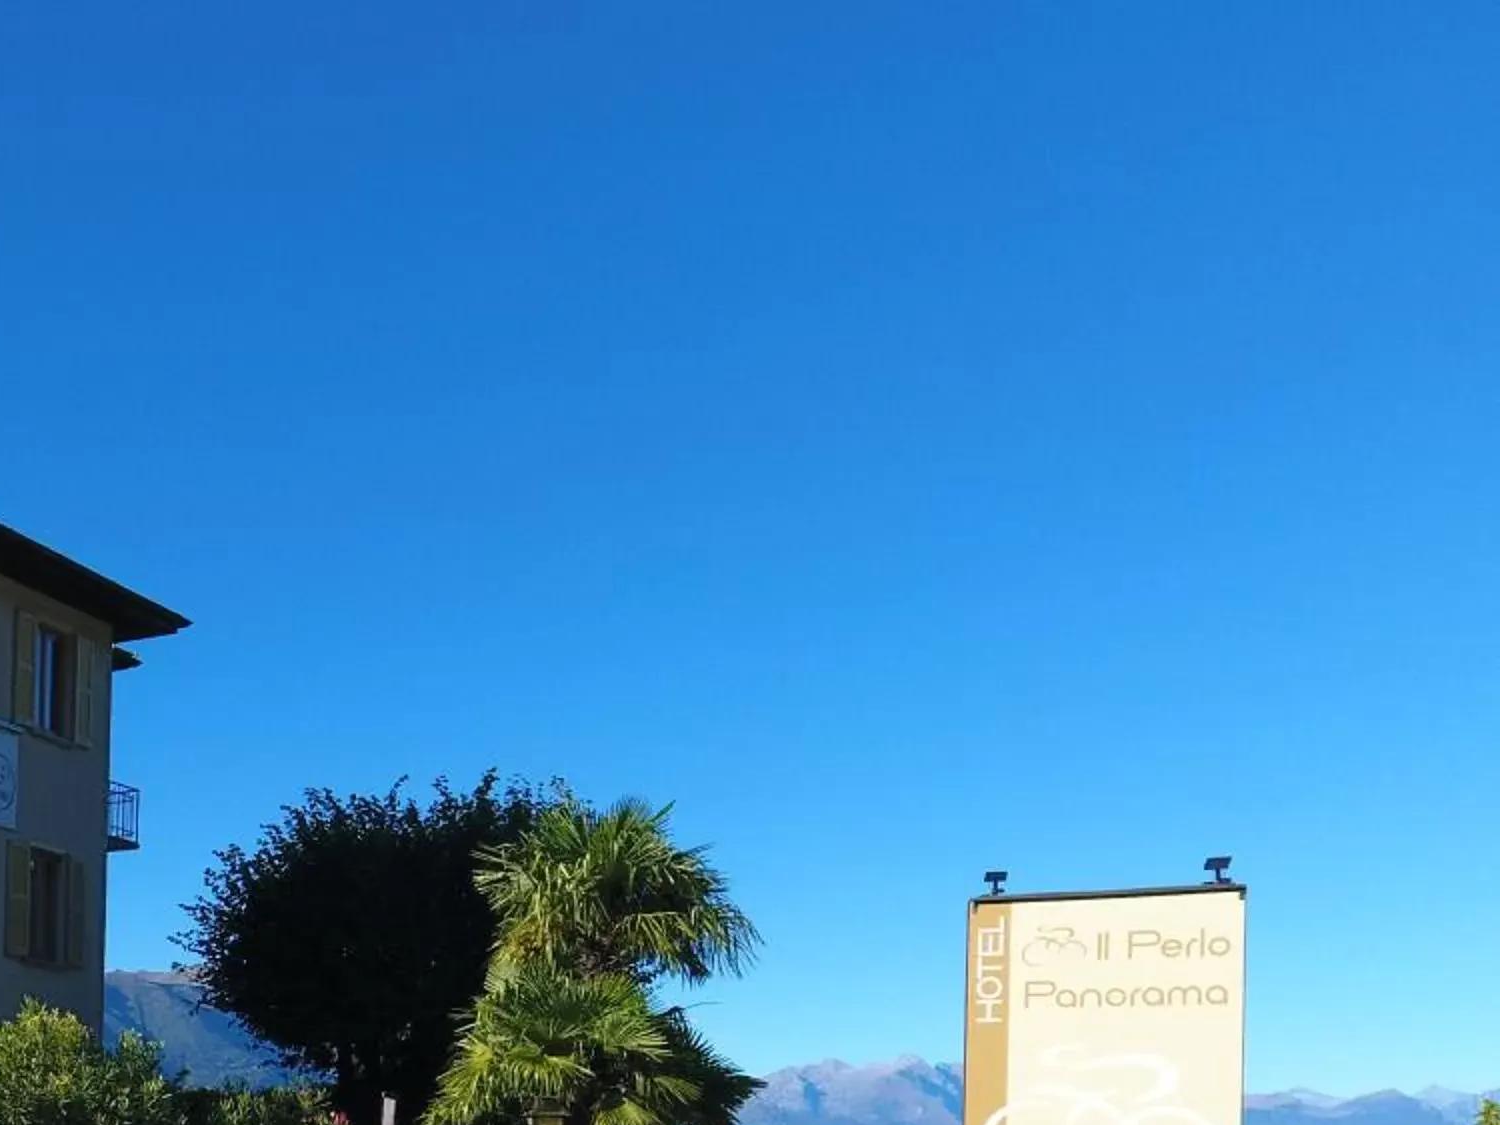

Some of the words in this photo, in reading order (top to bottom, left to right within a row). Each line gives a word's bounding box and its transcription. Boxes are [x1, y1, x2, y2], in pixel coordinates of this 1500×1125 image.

[1097, 932, 1110, 961] Il
[1127, 928, 1231, 960] Perlo
[975, 916, 1006, 1023] HOTEL
[1023, 980, 1229, 1009] Panorama
